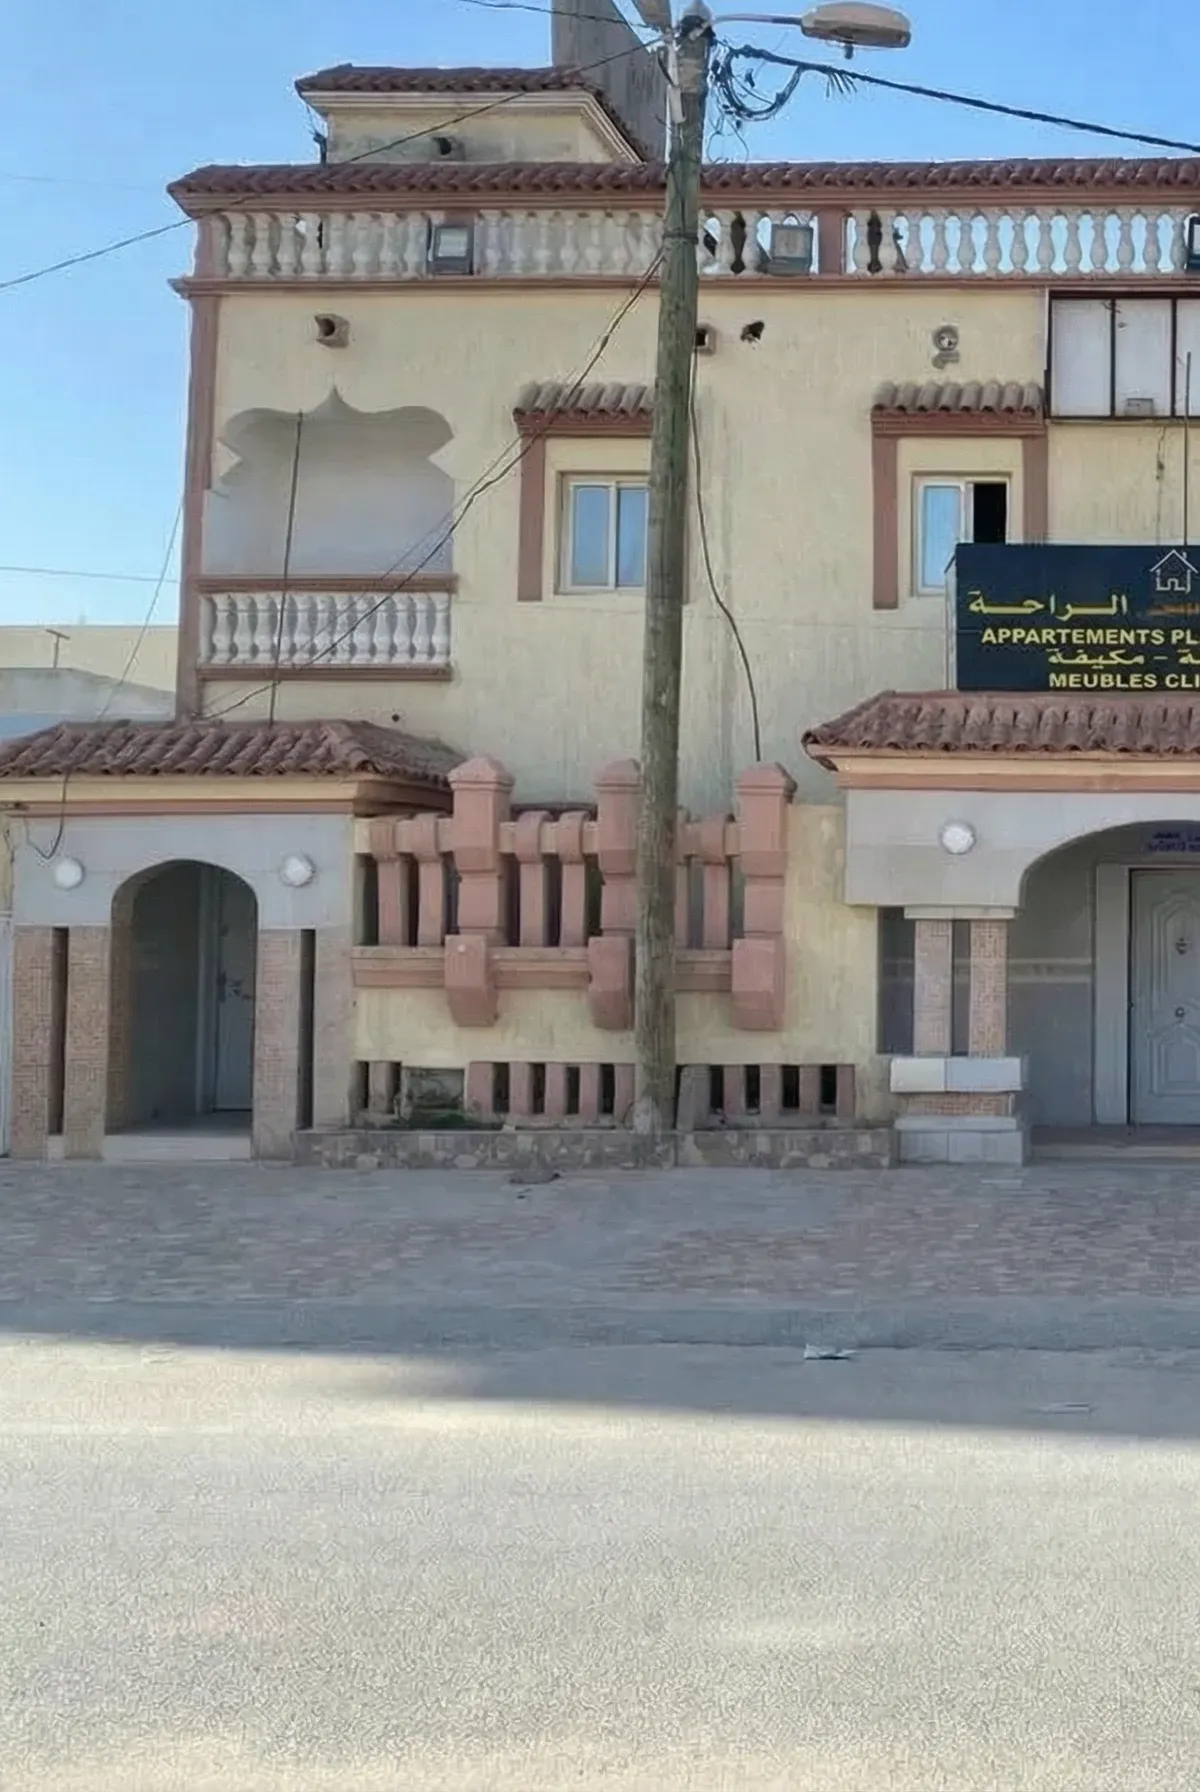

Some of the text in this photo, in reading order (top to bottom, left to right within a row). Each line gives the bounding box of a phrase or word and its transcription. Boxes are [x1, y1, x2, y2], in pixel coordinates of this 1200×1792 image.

[968, 590, 1128, 622] الراحة
[981, 628, 1165, 645] APPARTEMENTS
[1045, 648, 1144, 670] مكيفة
[1049, 673, 1157, 689] MEUBLES
